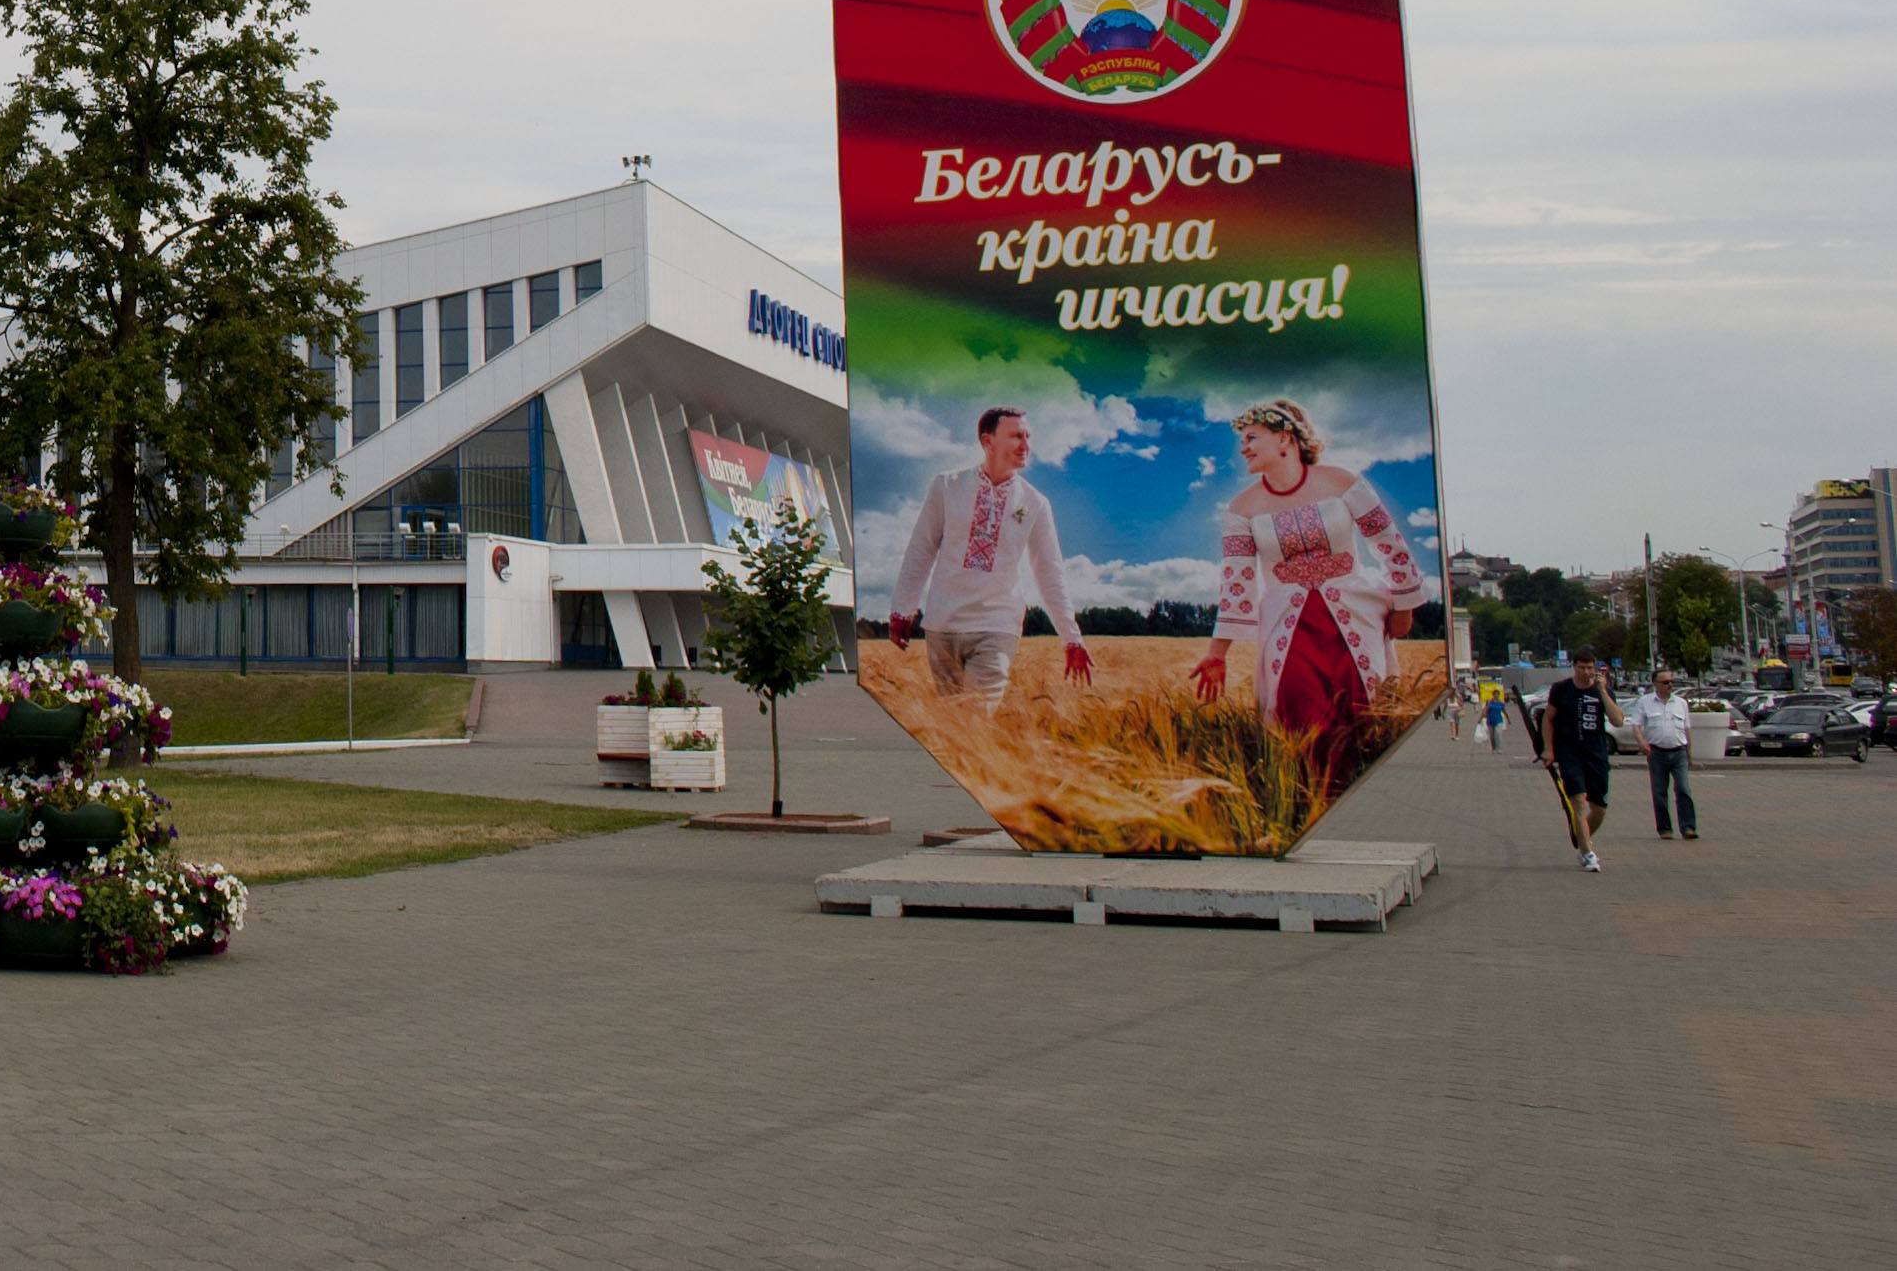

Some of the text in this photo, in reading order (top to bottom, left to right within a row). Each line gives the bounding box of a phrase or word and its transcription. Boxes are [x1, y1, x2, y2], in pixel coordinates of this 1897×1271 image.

[1080, 57, 1161, 77] РЭСПУБЛІКА
[1088, 74, 1156, 92] БЕЛАРУСЬ
[914, 140, 1282, 208] Беларусь-
[976, 208, 1219, 284] краіна
[748, 288, 846, 372] ДВОРЕЦ СПО
[1054, 264, 1351, 334] шчасця!
